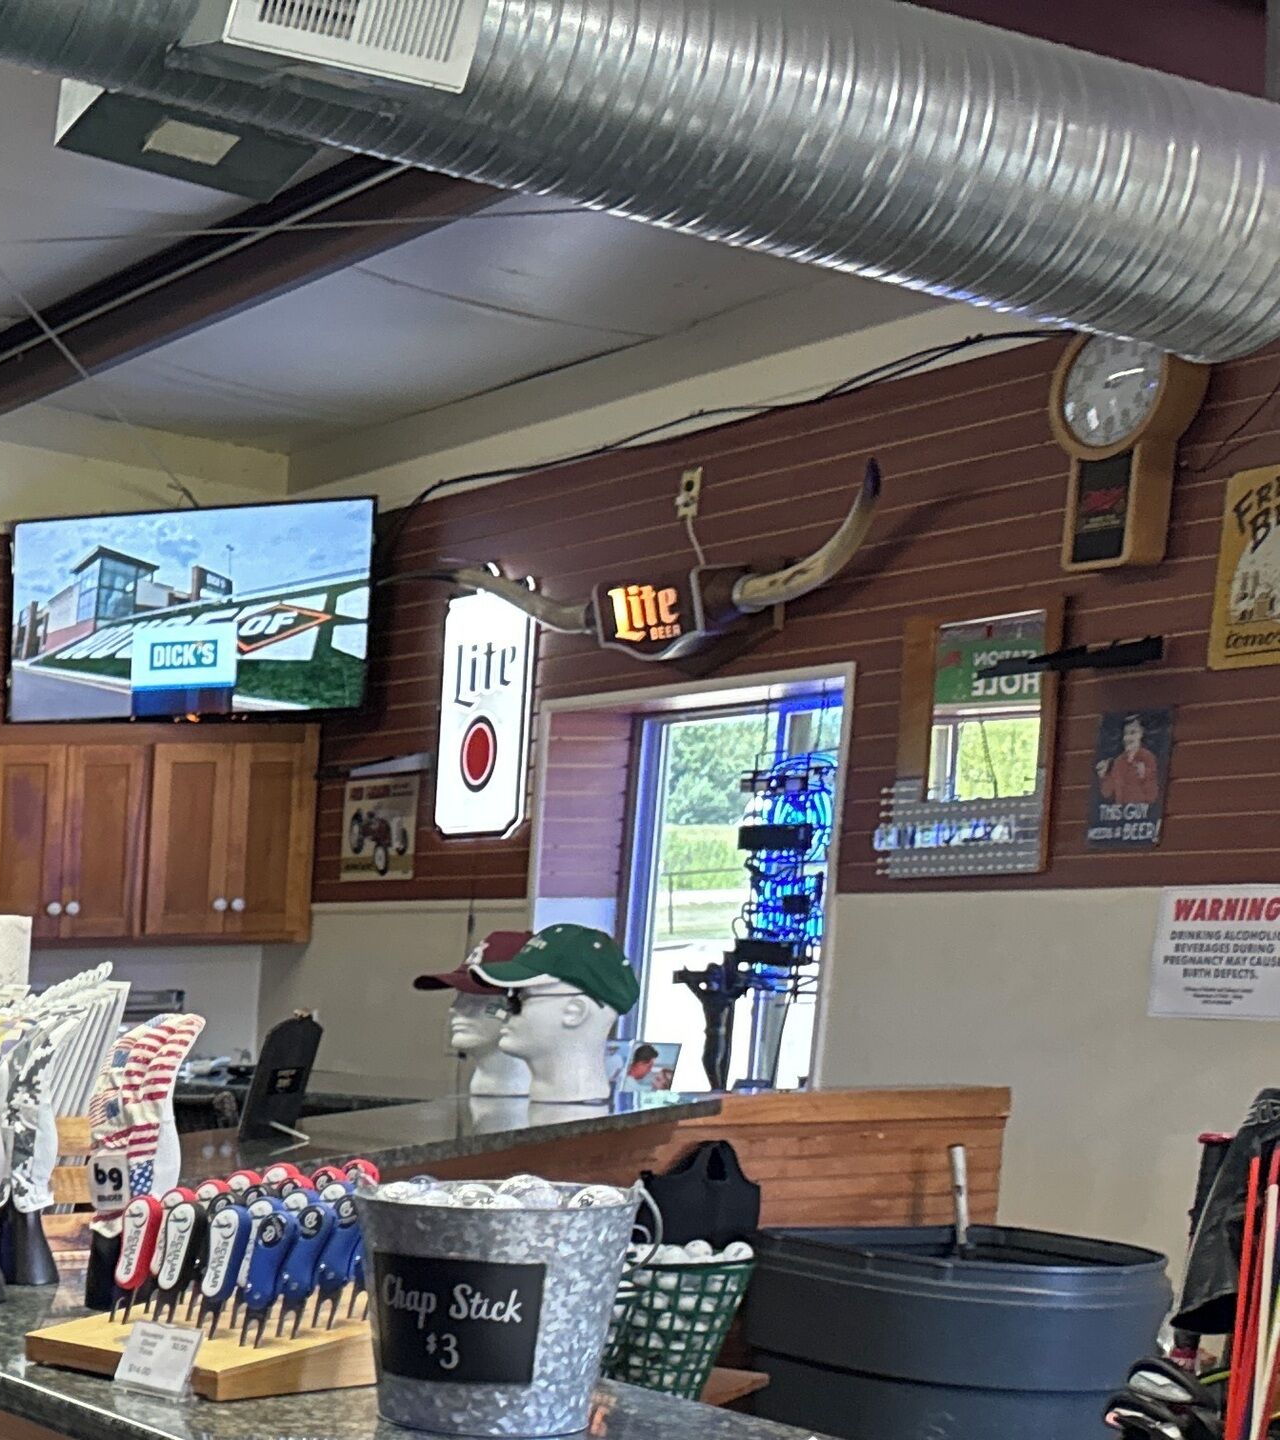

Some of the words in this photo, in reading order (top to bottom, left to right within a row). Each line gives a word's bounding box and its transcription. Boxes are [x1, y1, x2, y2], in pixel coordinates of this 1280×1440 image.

[238, 611, 299, 636] OF
[607, 584, 681, 643] Lite
[649, 625, 682, 641] BEER
[151, 642, 215, 667] DICK'S
[453, 641, 517, 708] Lite
[1099, 803, 1122, 821] THIS
[1123, 803, 1149, 820] GUY
[1122, 818, 1162, 843] BEER!
[1173, 897, 1280, 922] WARNING
[1169, 930, 1222, 941] DRINKING
[1163, 955, 1224, 966] PREGNANCY
[1225, 956, 1248, 966] MAY
[1174, 943, 1231, 953] BEVERAGES
[1232, 943, 1275, 954] DURING
[1182, 968, 1212, 979] BIRTH
[1214, 968, 1258, 979] DEFECTS.
[93, 1162, 123, 1192] bg
[382, 1274, 437, 1330] Chap
[449, 1282, 523, 1325] Stick
[426, 1333, 459, 1370] $3
